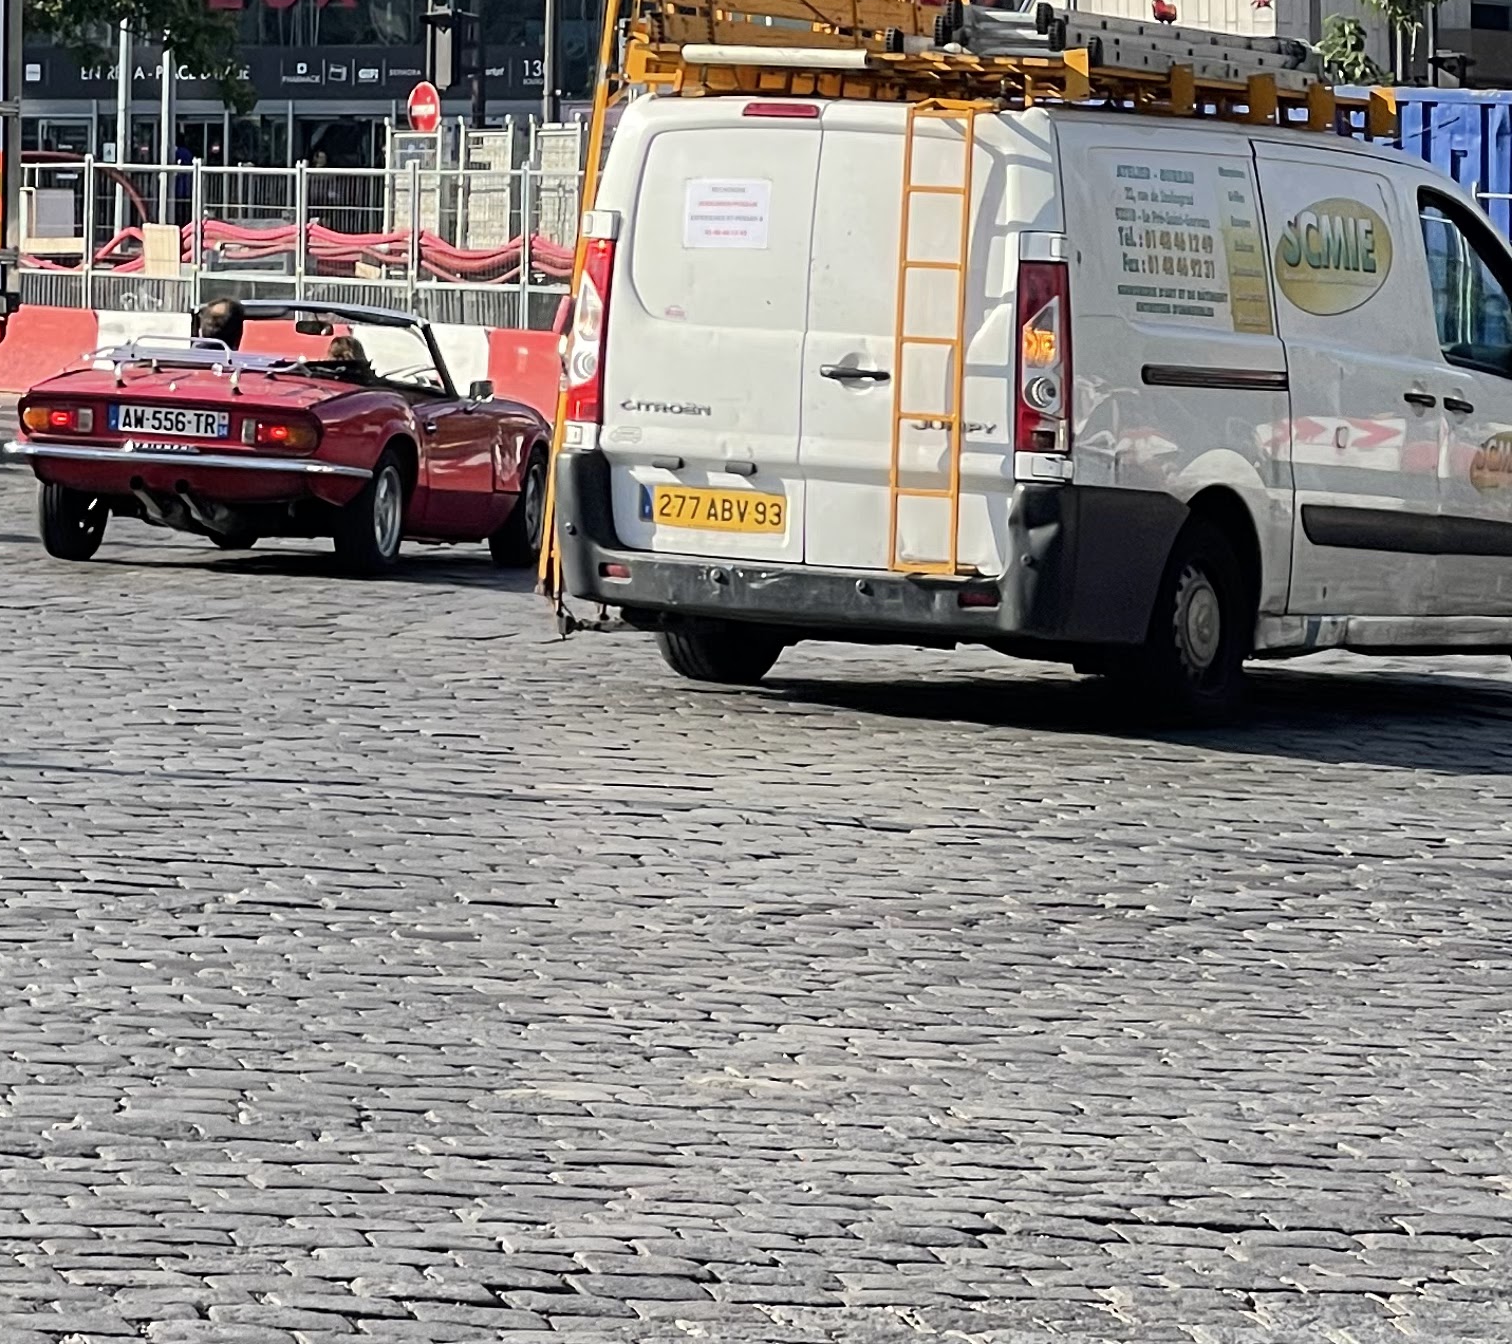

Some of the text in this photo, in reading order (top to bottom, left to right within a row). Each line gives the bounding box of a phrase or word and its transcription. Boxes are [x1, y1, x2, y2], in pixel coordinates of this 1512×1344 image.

[1283, 211, 1376, 273] SCMIE
[659, 494, 782, 526] 277 ABV 93
